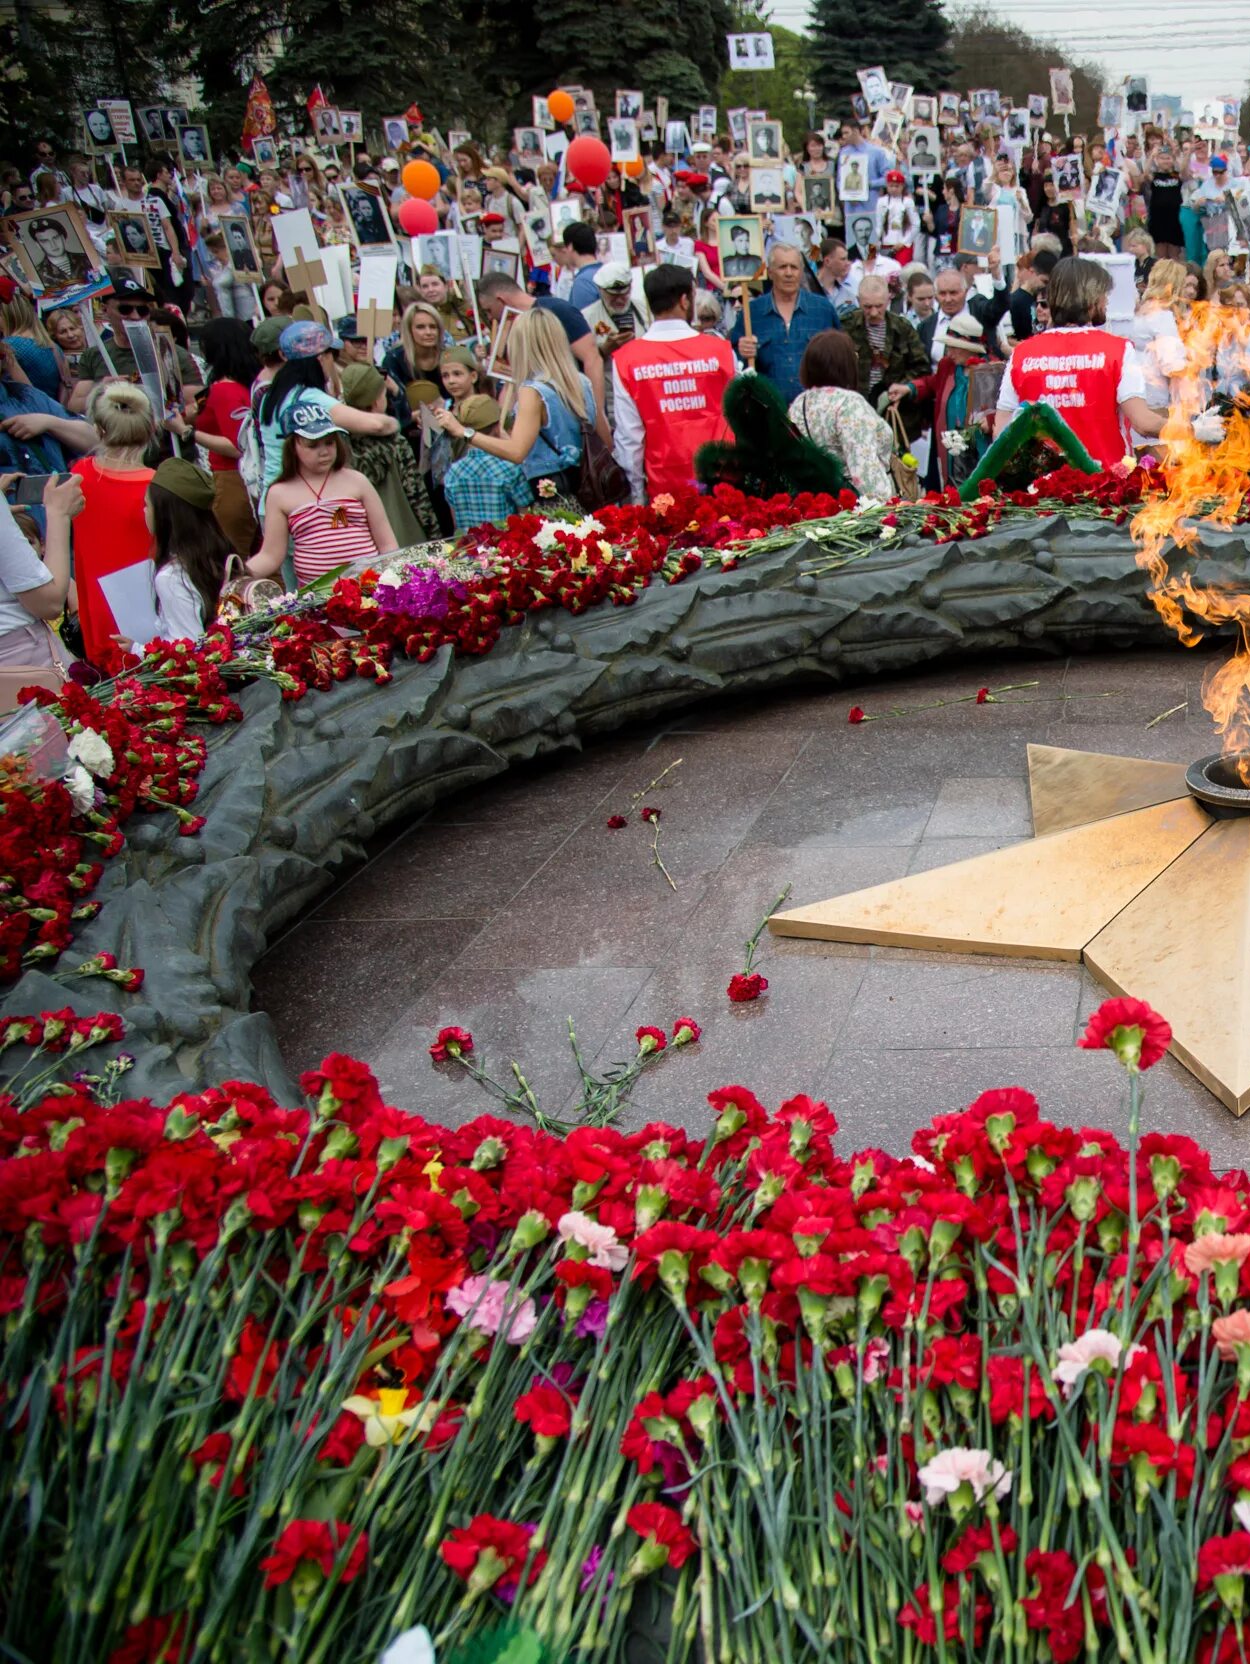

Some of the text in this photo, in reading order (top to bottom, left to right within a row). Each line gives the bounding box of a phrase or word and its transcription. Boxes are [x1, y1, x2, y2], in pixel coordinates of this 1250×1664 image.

[634, 356, 720, 381] БЕССМЕРТНЫЙ
[663, 378, 698, 395] ПОЛК
[659, 395, 707, 414] РОССИИ
